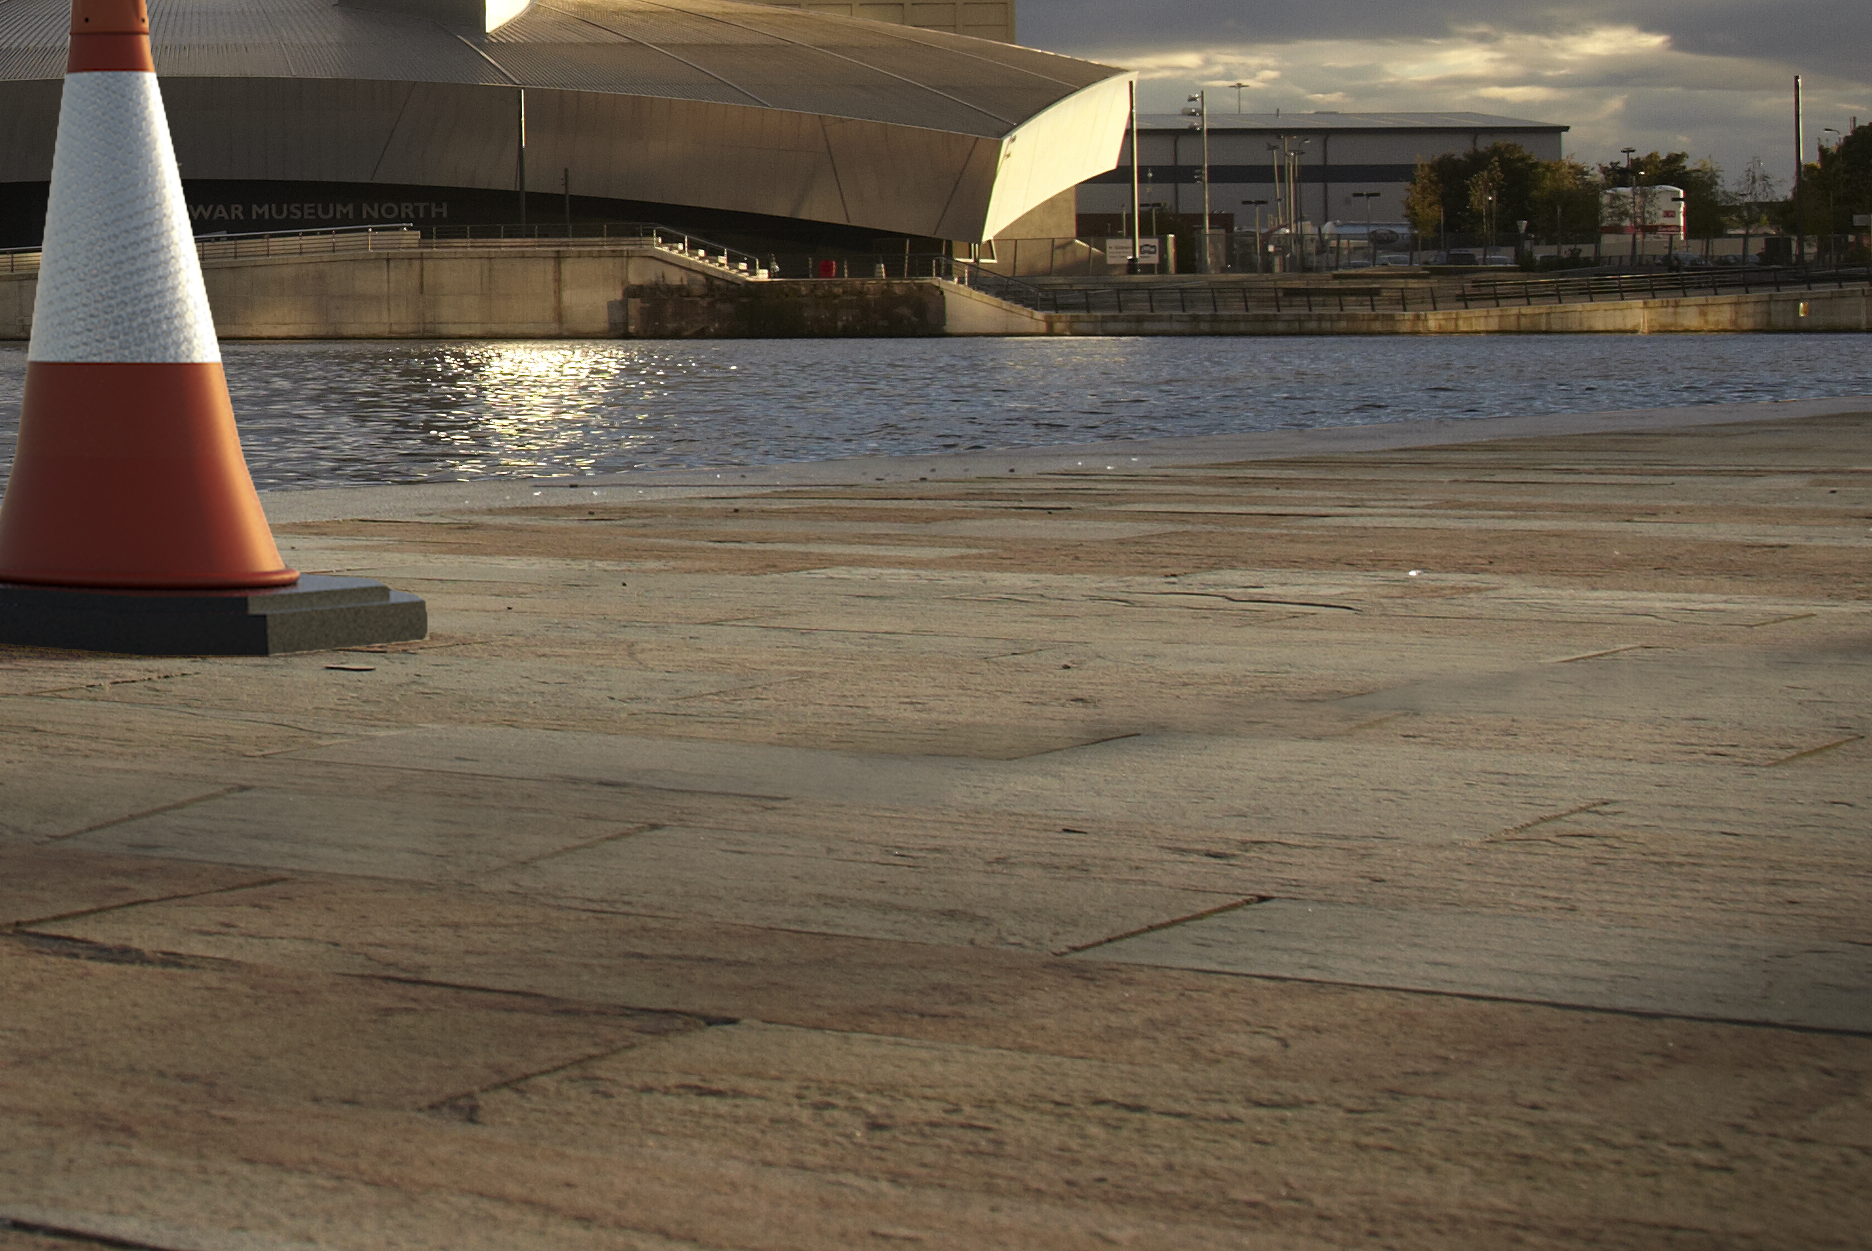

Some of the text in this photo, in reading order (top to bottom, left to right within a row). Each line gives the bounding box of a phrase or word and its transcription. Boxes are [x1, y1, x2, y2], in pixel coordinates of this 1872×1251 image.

[188, 201, 448, 220] WAR MUSEUM NORTH
